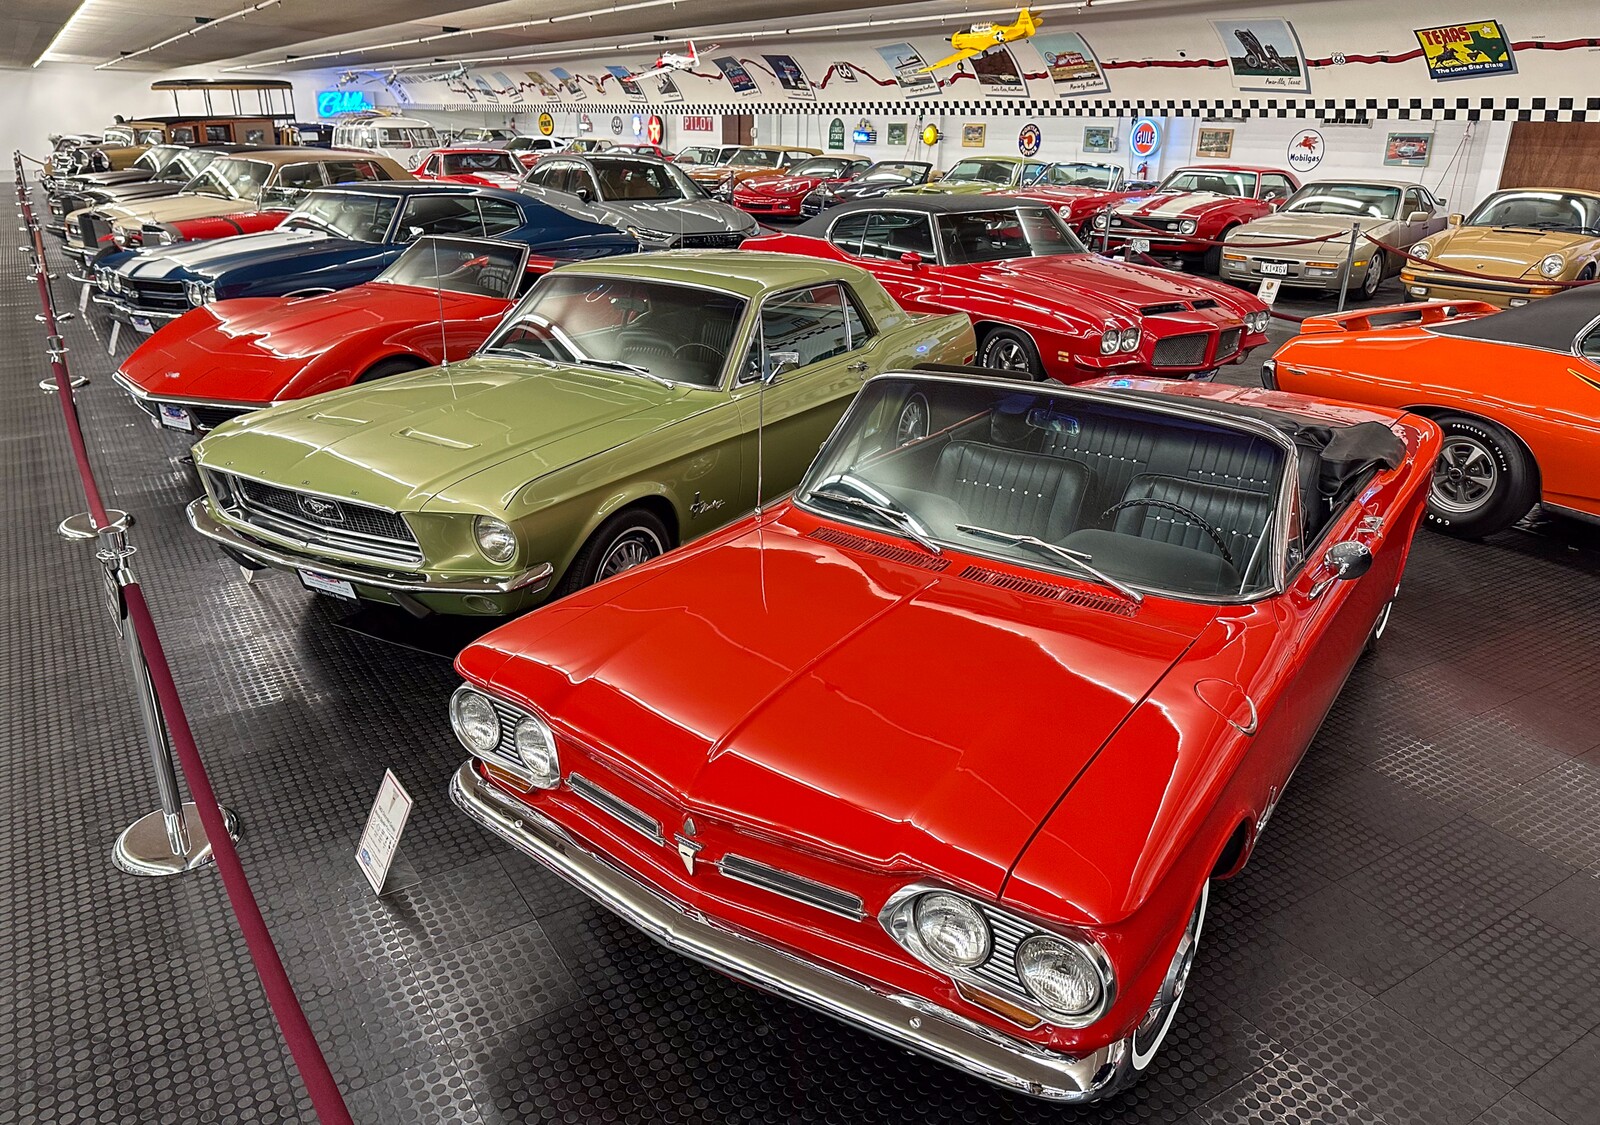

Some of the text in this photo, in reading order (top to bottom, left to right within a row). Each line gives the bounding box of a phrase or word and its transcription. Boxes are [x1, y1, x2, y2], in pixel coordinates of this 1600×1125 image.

[1421, 26, 1472, 46] TEXAS
[1333, 54, 1345, 64] 66
[837, 64, 852, 78] 66
[1450, 65, 1468, 74] Lone
[1468, 63, 1484, 71] Star
[1484, 62, 1504, 70] State
[1265, 77, 1301, 87] Amarillo, Texas
[684, 117, 713, 130] PILOT
[1021, 125, 1039, 137] PONTIAC
[1135, 130, 1156, 145] GULF
[1289, 153, 1320, 163] Mobilgas
[1452, 423, 1487, 438] POLYGLAS
